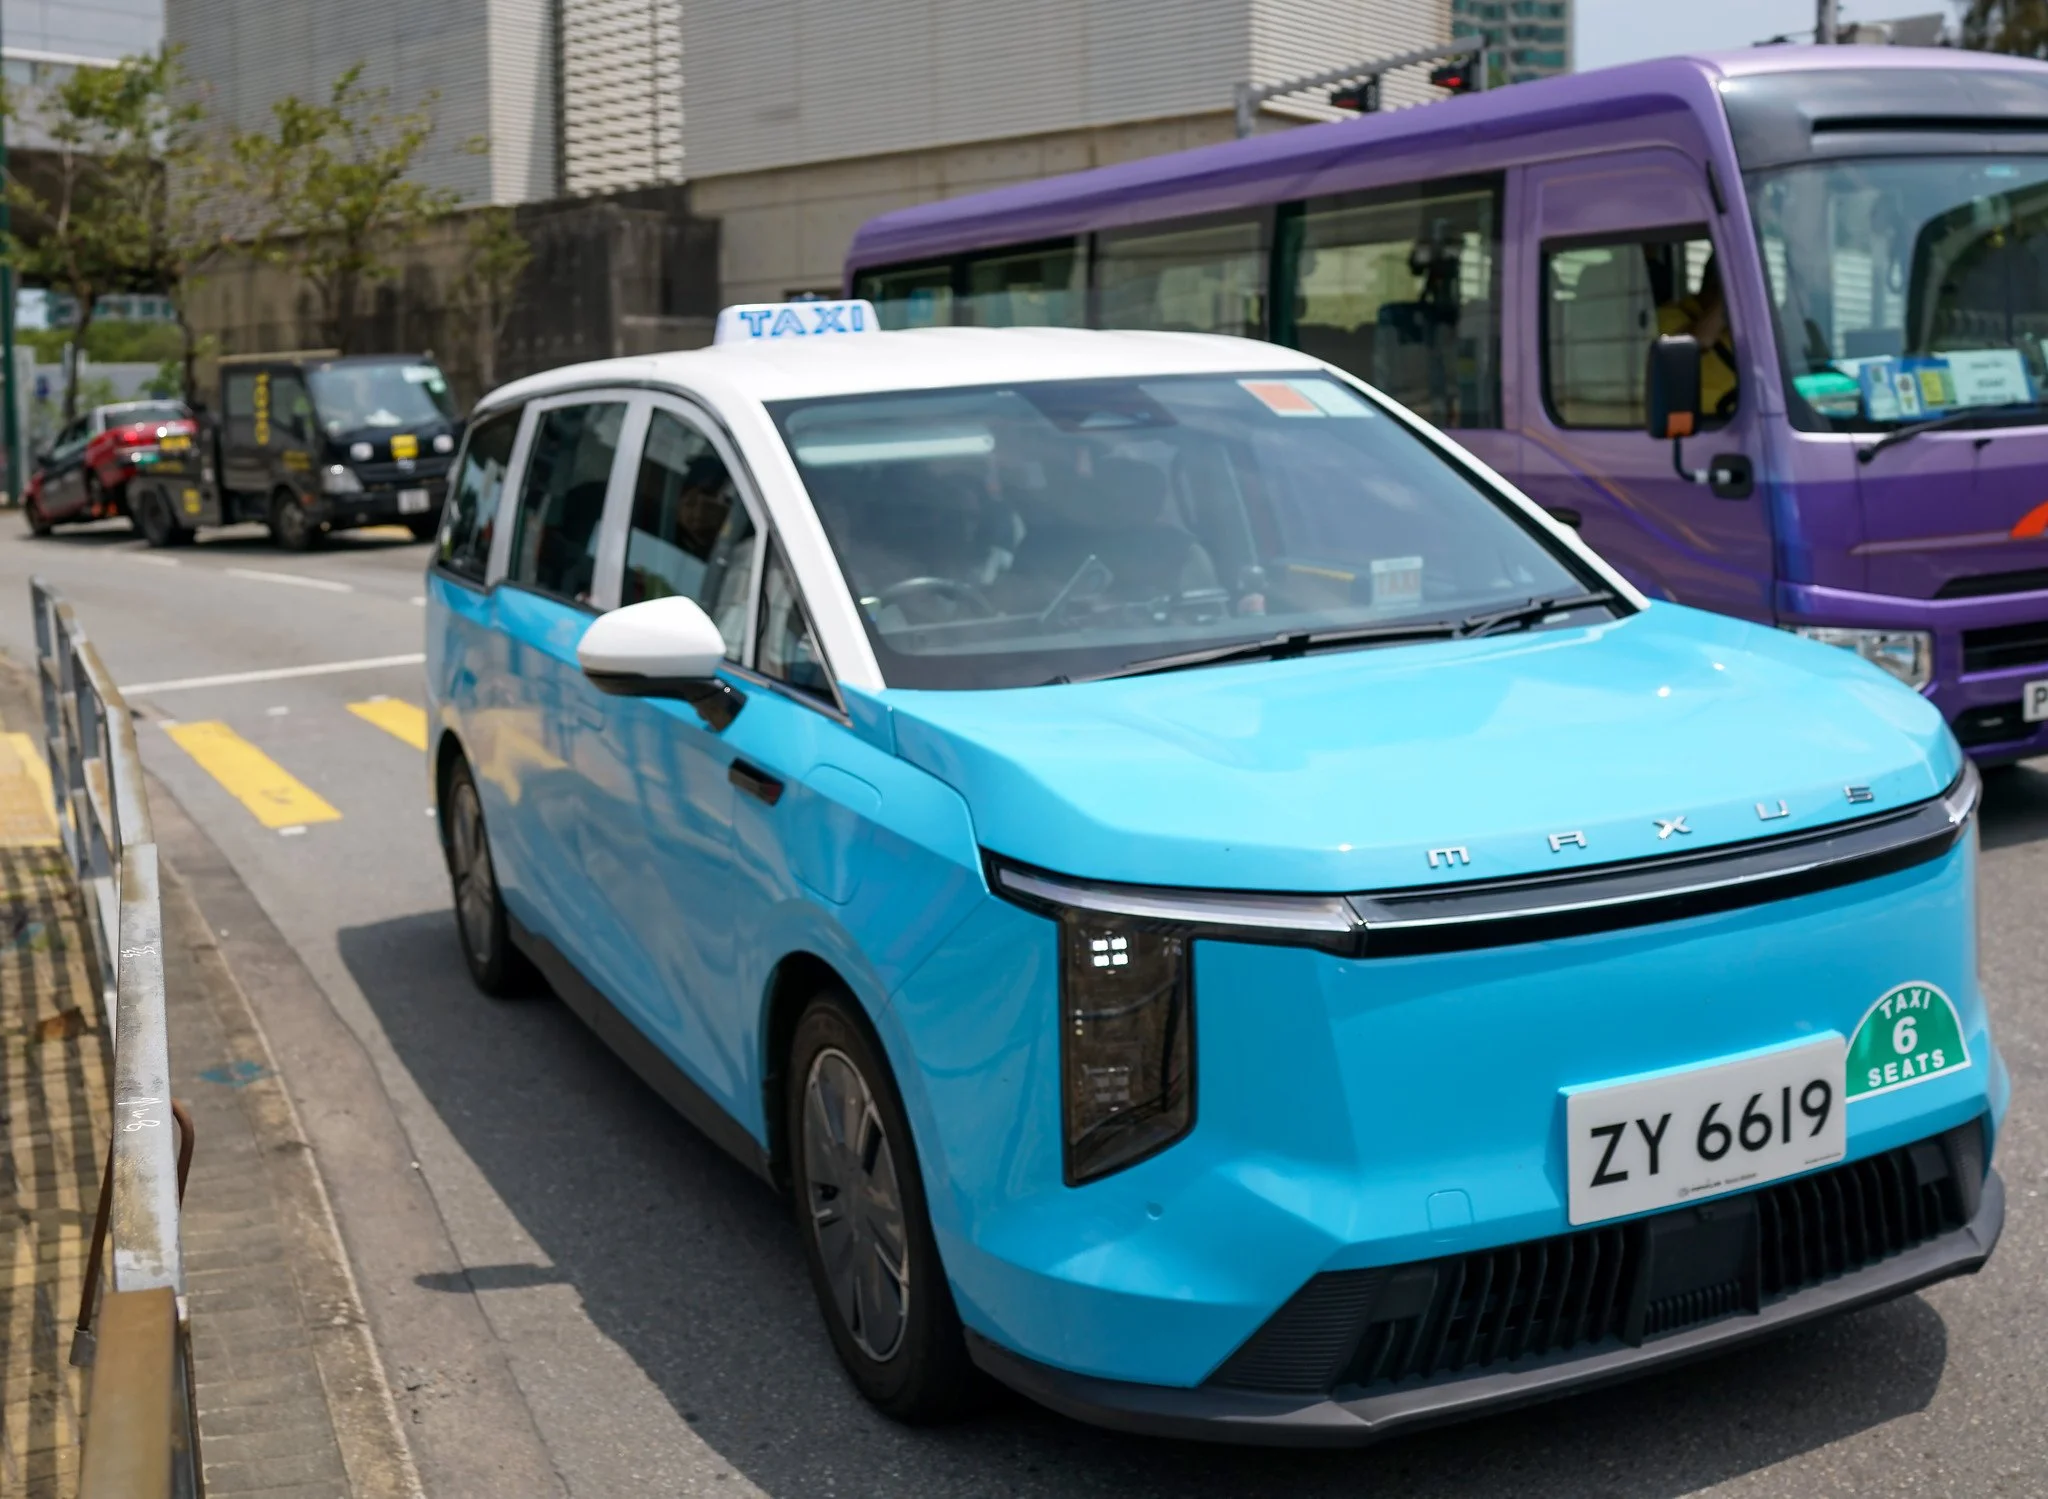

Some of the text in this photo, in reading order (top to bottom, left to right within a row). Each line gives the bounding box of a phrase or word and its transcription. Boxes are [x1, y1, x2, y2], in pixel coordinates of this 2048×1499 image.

[740, 305, 864, 337] TAXI
[1427, 784, 1875, 868] MAXUS
[1879, 988, 1932, 1020] TAXI
[1892, 1015, 1918, 1055] 6
[1868, 1048, 1946, 1088] SEATS
[1589, 1078, 1832, 1188] ZY 6619
